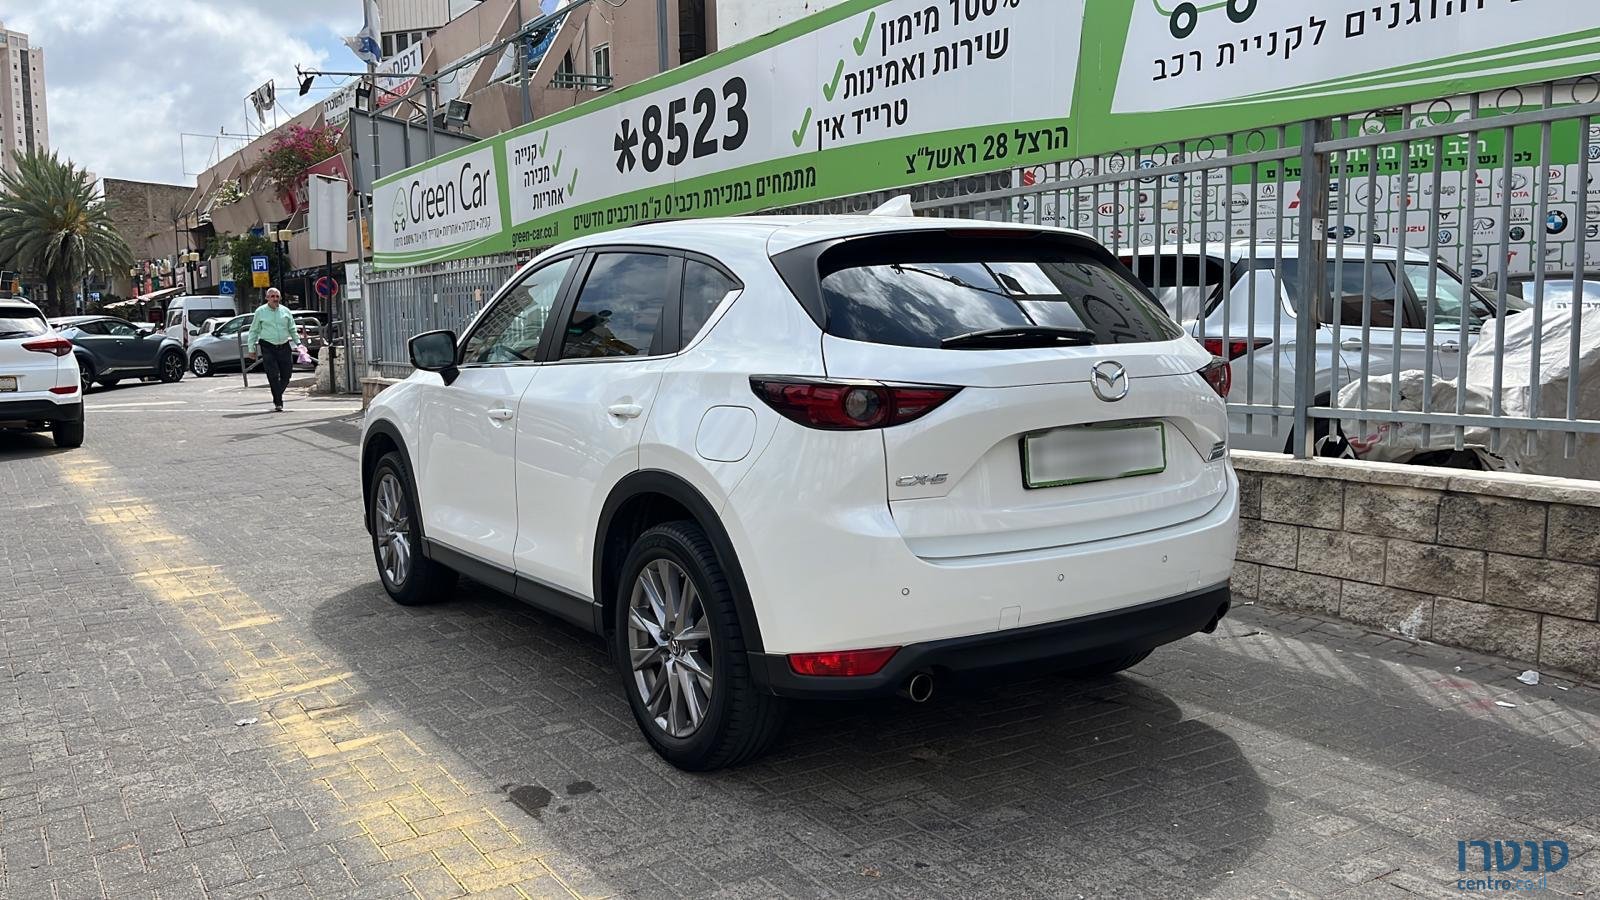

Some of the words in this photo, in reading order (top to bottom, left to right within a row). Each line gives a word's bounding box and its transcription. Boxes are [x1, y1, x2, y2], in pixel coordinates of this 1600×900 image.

[880, 5, 939, 56] מימון
[1216, 15, 1327, 67] לקניית
[932, 27, 1009, 75] שירות
[843, 51, 925, 99] ואמינות
[1152, 50, 1202, 81] רכב
[851, 98, 908, 134] טרייד
[816, 114, 845, 151] אין
[983, 132, 1008, 161] 28
[1014, 126, 1069, 155] הרצל
[514, 143, 537, 166] קנייה
[524, 165, 550, 188] מכירה
[756, 166, 816, 197] מתמחים
[409, 180, 456, 224] Green
[459, 162, 490, 211] Car
[532, 187, 564, 211] אחריות
[664, 194, 672, 215] 0
[675, 191, 700, 213] רכבי
[703, 180, 751, 208] במכירת
[573, 210, 604, 231] חדשים
[606, 204, 638, 225] ורכבים
[511, 221, 559, 247] green-car.co.il
[1392, 225, 1426, 233] IUZU
[895, 472, 949, 487] CX-5
